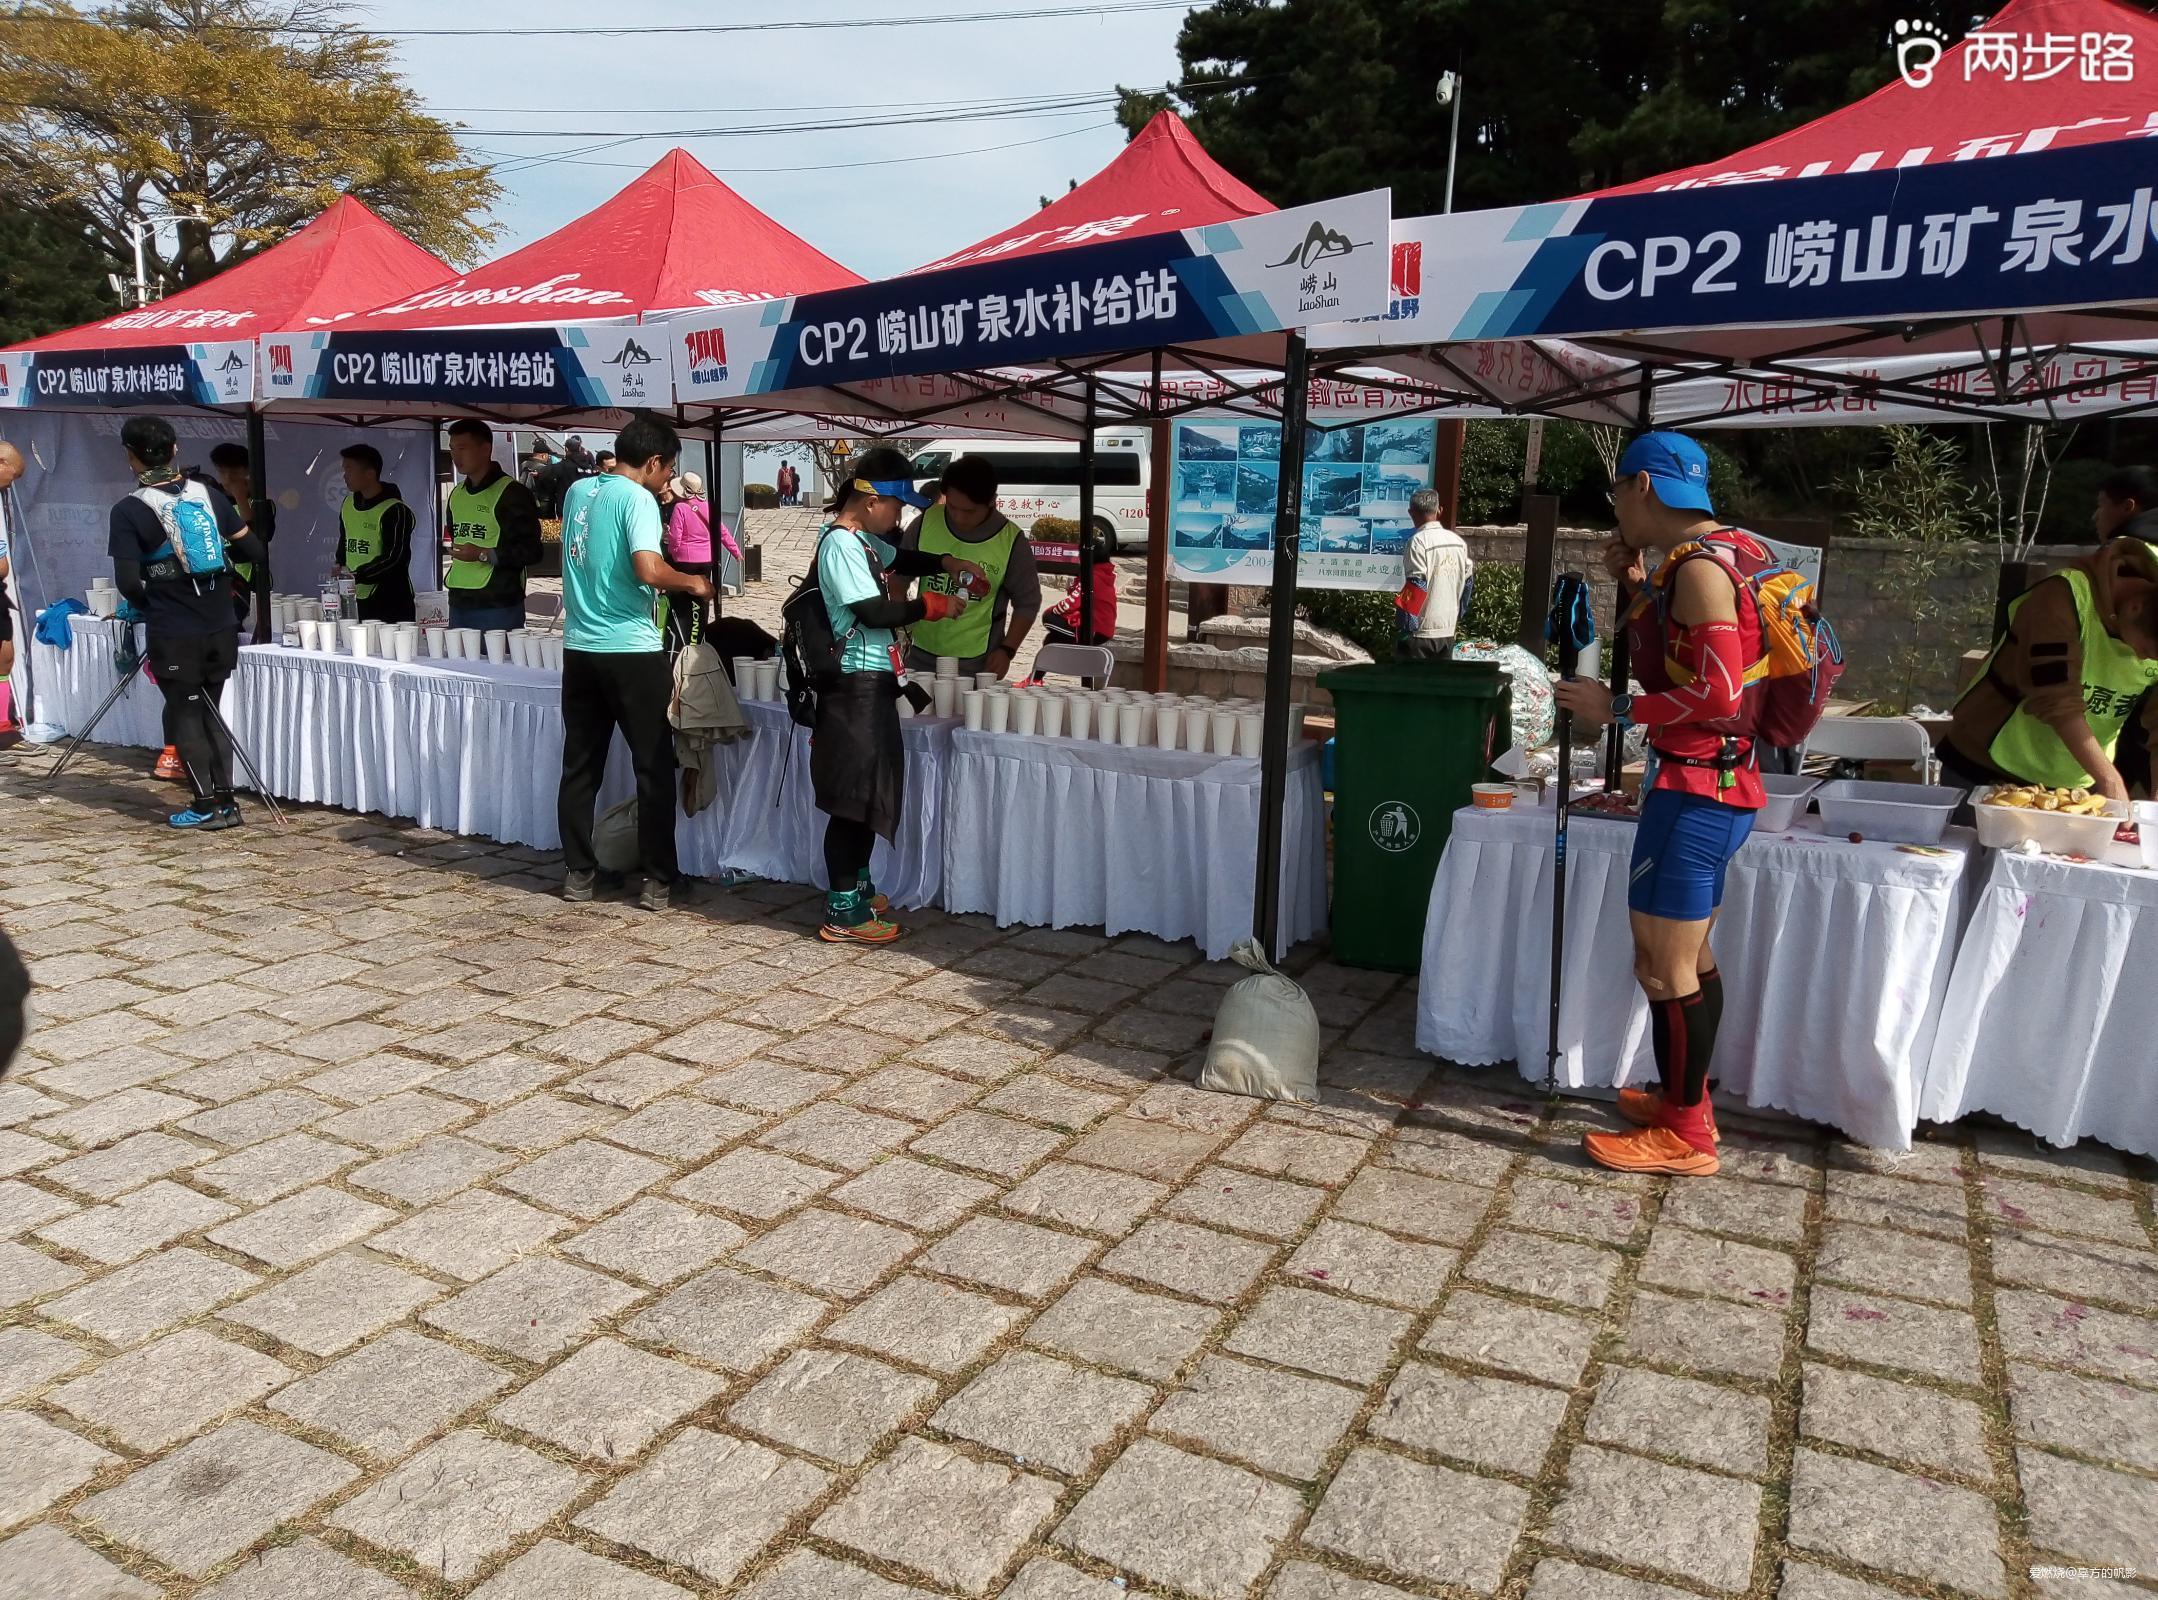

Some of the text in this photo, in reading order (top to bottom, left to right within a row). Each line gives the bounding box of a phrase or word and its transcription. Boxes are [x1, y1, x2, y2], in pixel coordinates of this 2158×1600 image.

[1584, 188, 2158, 301] CP2 崂山矿泉水
[1300, 271, 1337, 295] 崂山
[1298, 294, 1340, 313] LaoShan
[800, 268, 1178, 368] CP2 崂山矿泉水补给站
[37, 366, 69, 395] CP2
[71, 364, 185, 394] 崂山矿泉水补给站
[333, 351, 556, 389] CP2 崂山矿泉水补给站
[622, 373, 645, 388] 崂山
[1125, 508, 1144, 519] 120
[345, 539, 371, 555] 愿者
[2080, 681, 2142, 718] 愿者
